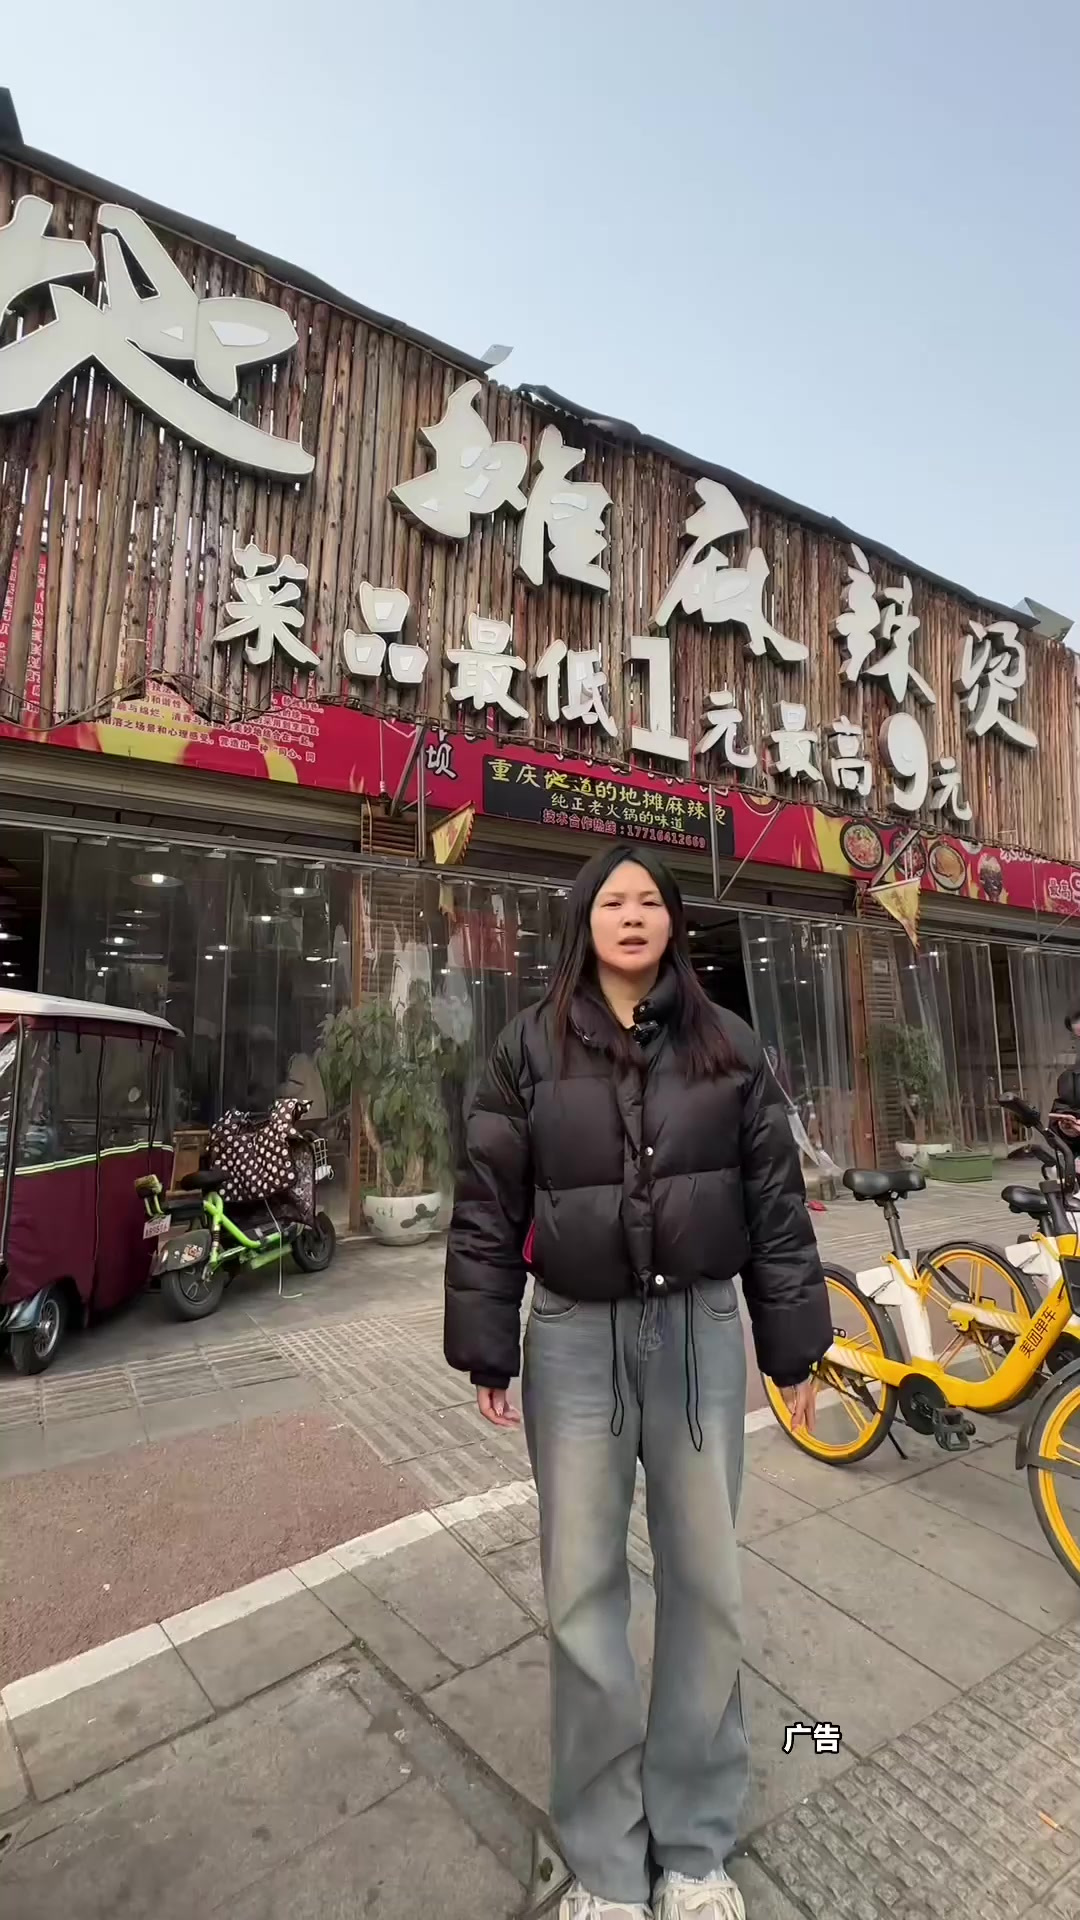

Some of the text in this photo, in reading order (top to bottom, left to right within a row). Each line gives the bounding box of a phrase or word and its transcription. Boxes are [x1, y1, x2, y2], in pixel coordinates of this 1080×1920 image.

[214, 544, 973, 822] 菜品最低1元最高9元
[551, 793, 686, 832] 纯正老火锅的味道
[1019, 1306, 1057, 1359] 美团单车
